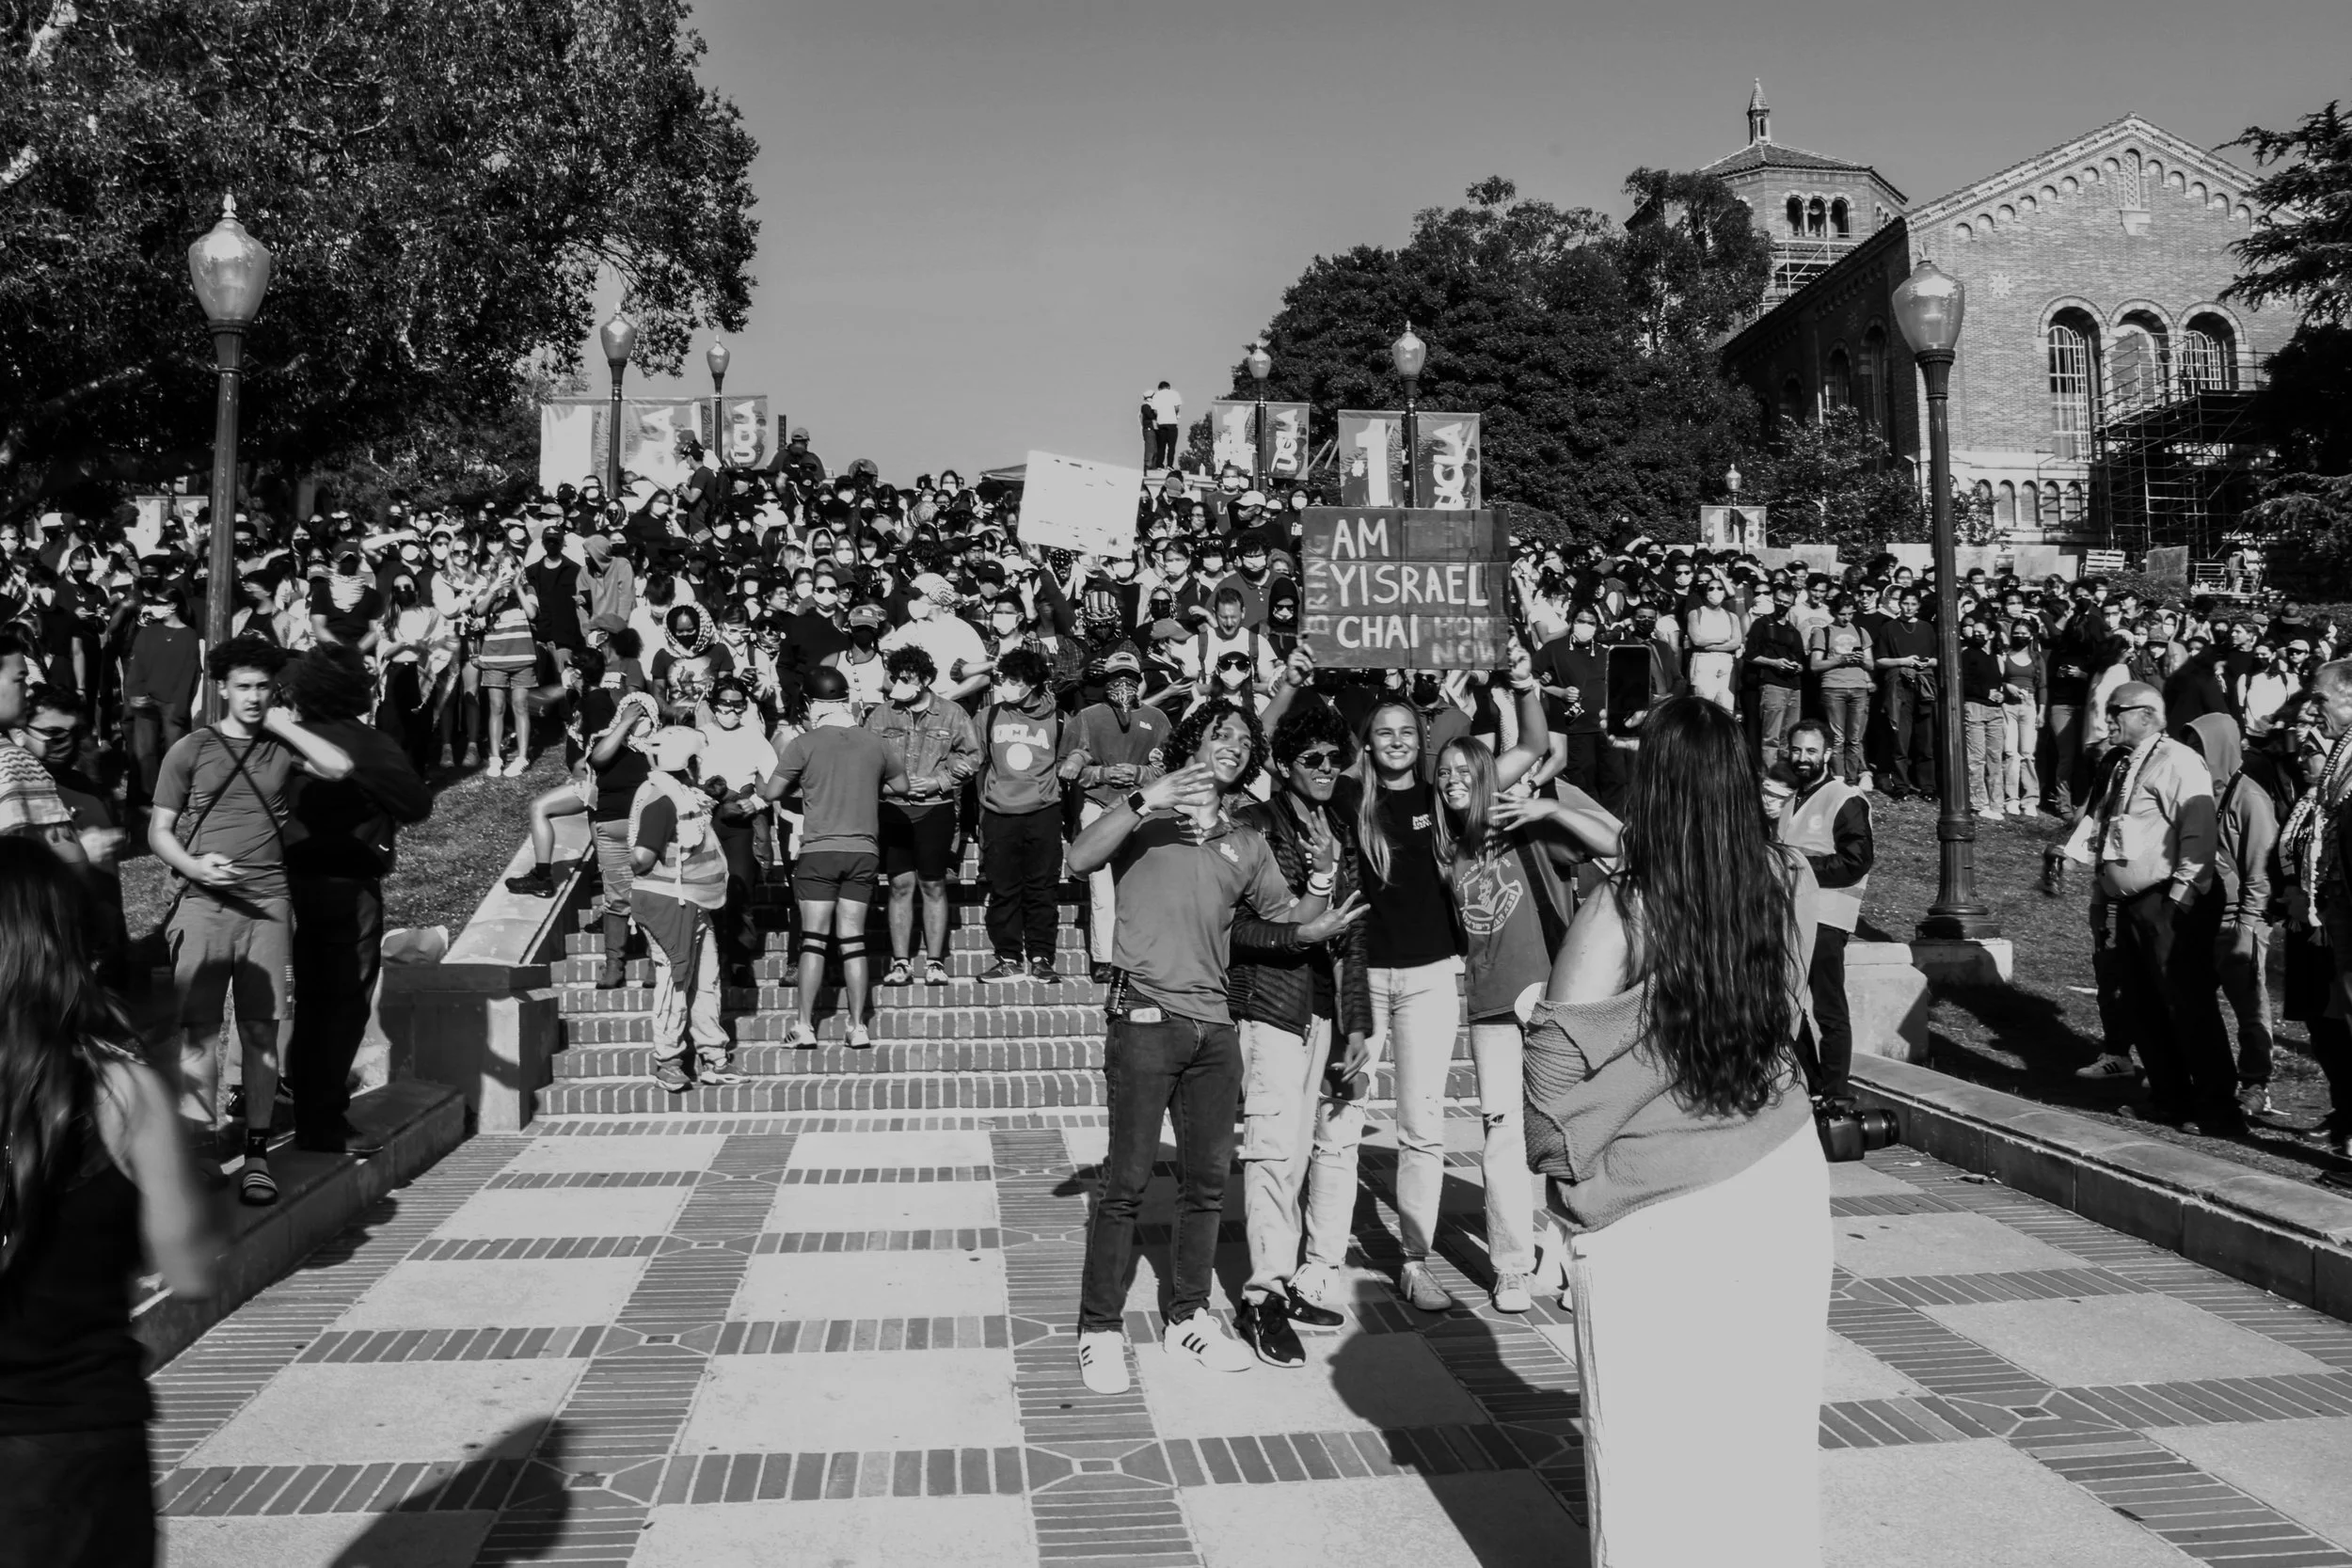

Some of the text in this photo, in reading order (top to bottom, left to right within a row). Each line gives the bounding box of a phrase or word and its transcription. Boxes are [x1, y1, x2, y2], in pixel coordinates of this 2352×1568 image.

[1331, 517, 1389, 560] AM
[1329, 563, 1489, 607] YISRAEL
[1336, 614, 1419, 649] CHAI
[993, 723, 1050, 750] UCLA
